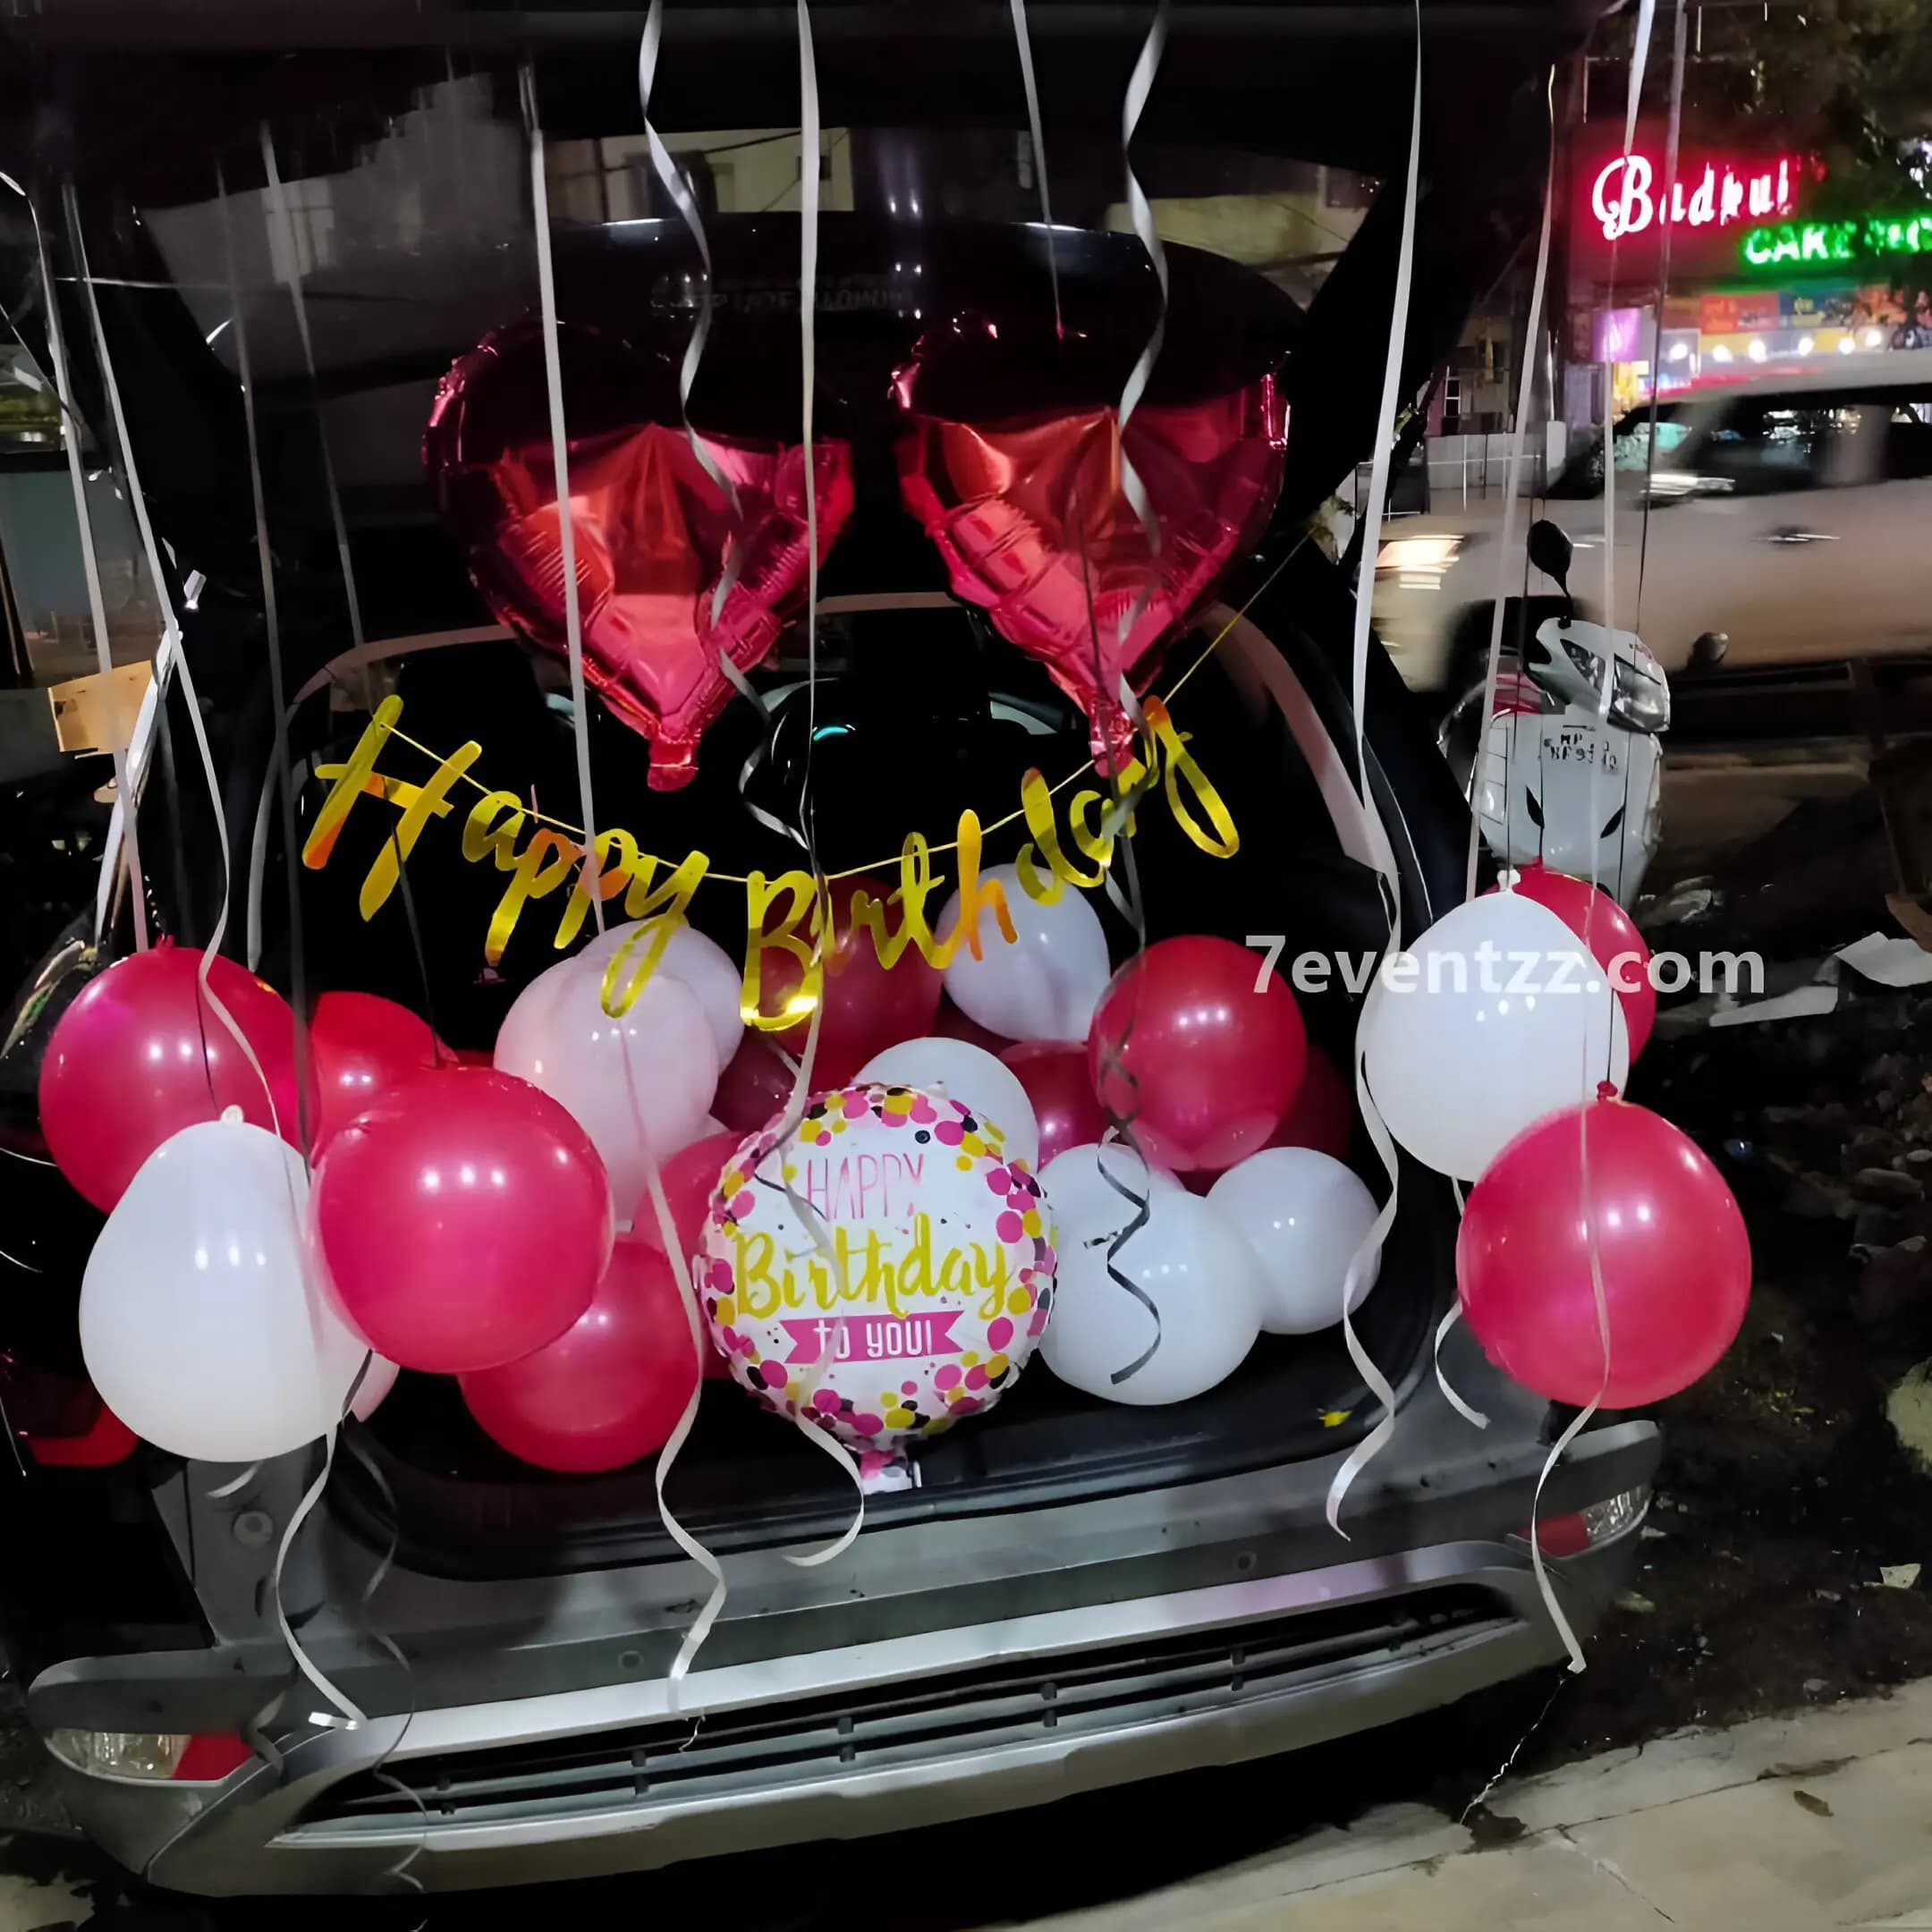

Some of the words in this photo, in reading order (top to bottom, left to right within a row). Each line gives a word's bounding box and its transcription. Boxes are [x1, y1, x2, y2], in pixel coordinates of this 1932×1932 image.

[302, 695, 709, 1018] Happy
[807, 1153, 924, 1220] HAPPY
[735, 1212, 1011, 1320] Birthday
